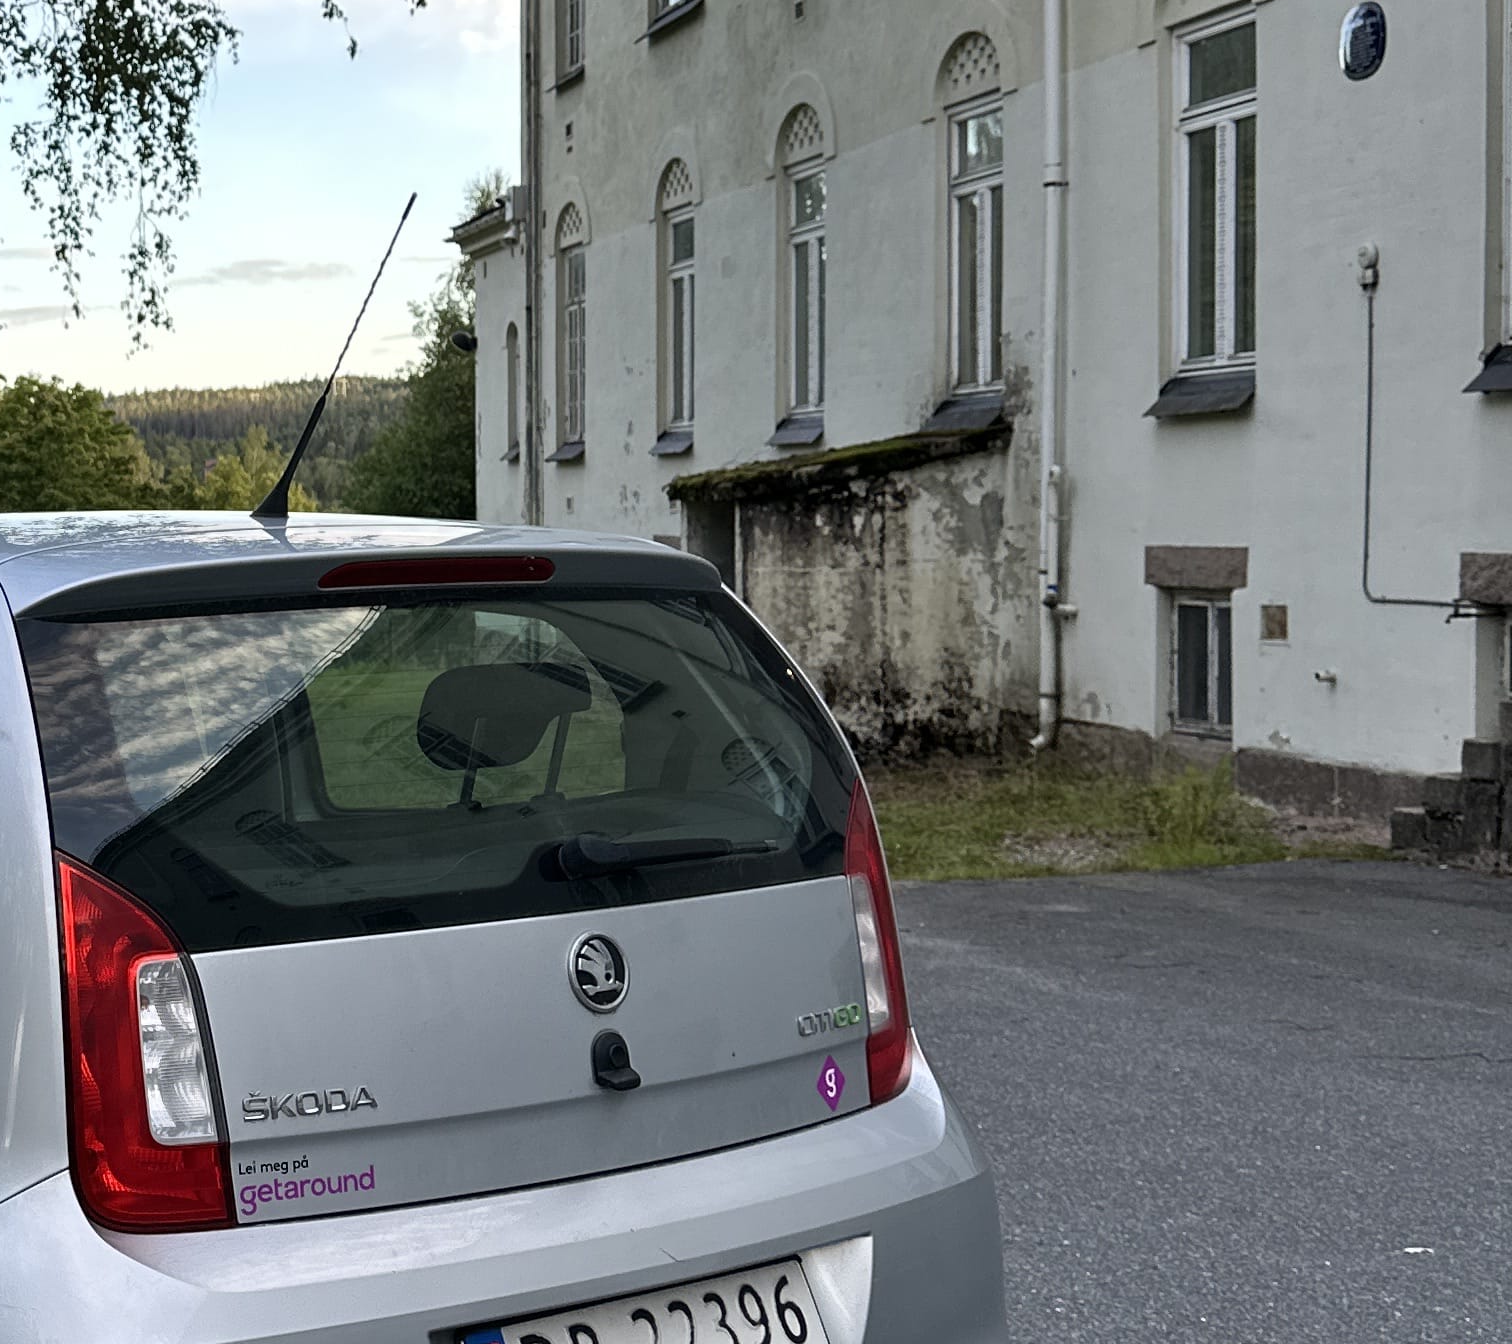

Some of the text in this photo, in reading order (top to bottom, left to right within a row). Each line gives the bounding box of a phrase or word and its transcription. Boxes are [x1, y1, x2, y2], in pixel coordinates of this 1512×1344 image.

[241, 1085, 379, 1123] ŠKODA
[238, 1154, 309, 1175] Lei meg på
[239, 1164, 376, 1216] getaround
